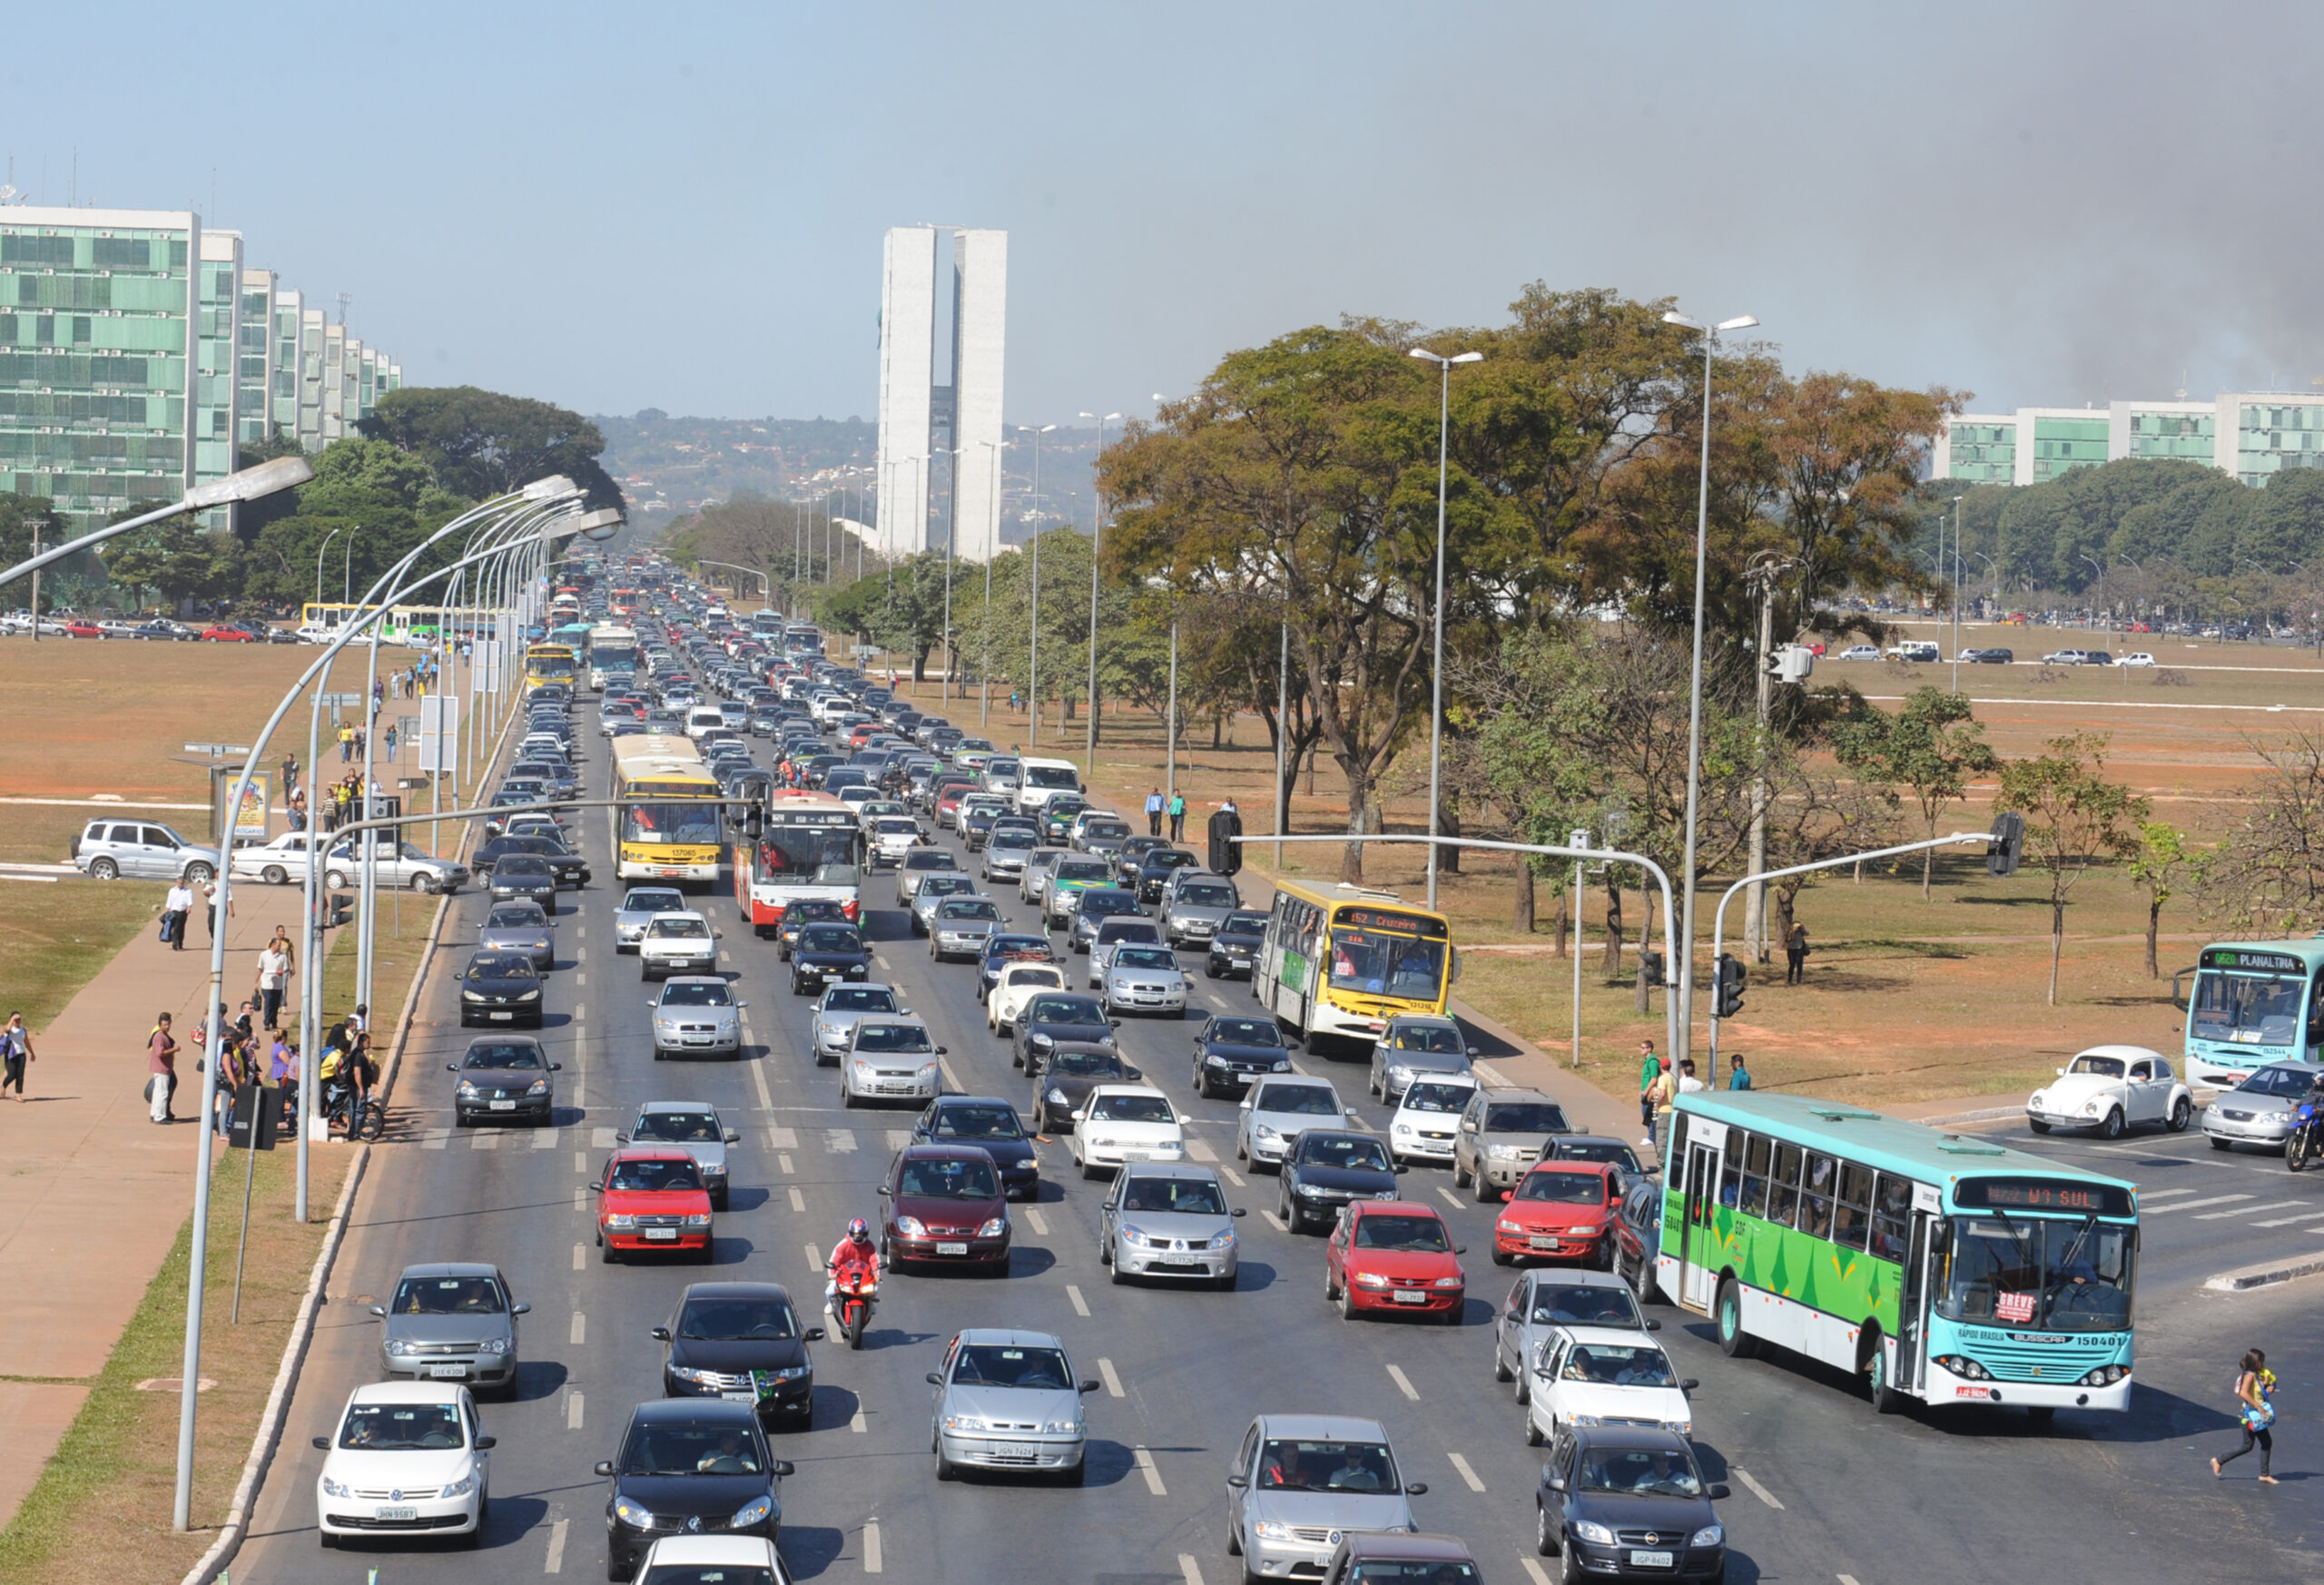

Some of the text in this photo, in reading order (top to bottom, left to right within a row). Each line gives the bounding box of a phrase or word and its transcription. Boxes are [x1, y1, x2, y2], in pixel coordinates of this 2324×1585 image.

[1351, 912, 1417, 930] 152 Cruzeiro
[2240, 954, 2295, 970] PLANALTINA
[2060, 1189, 2092, 1206] SUL
[1999, 1292, 2034, 1308] GREVE
[2014, 1334, 2066, 1344] BUSSCAR
[2076, 1336, 2122, 1346] 150401
